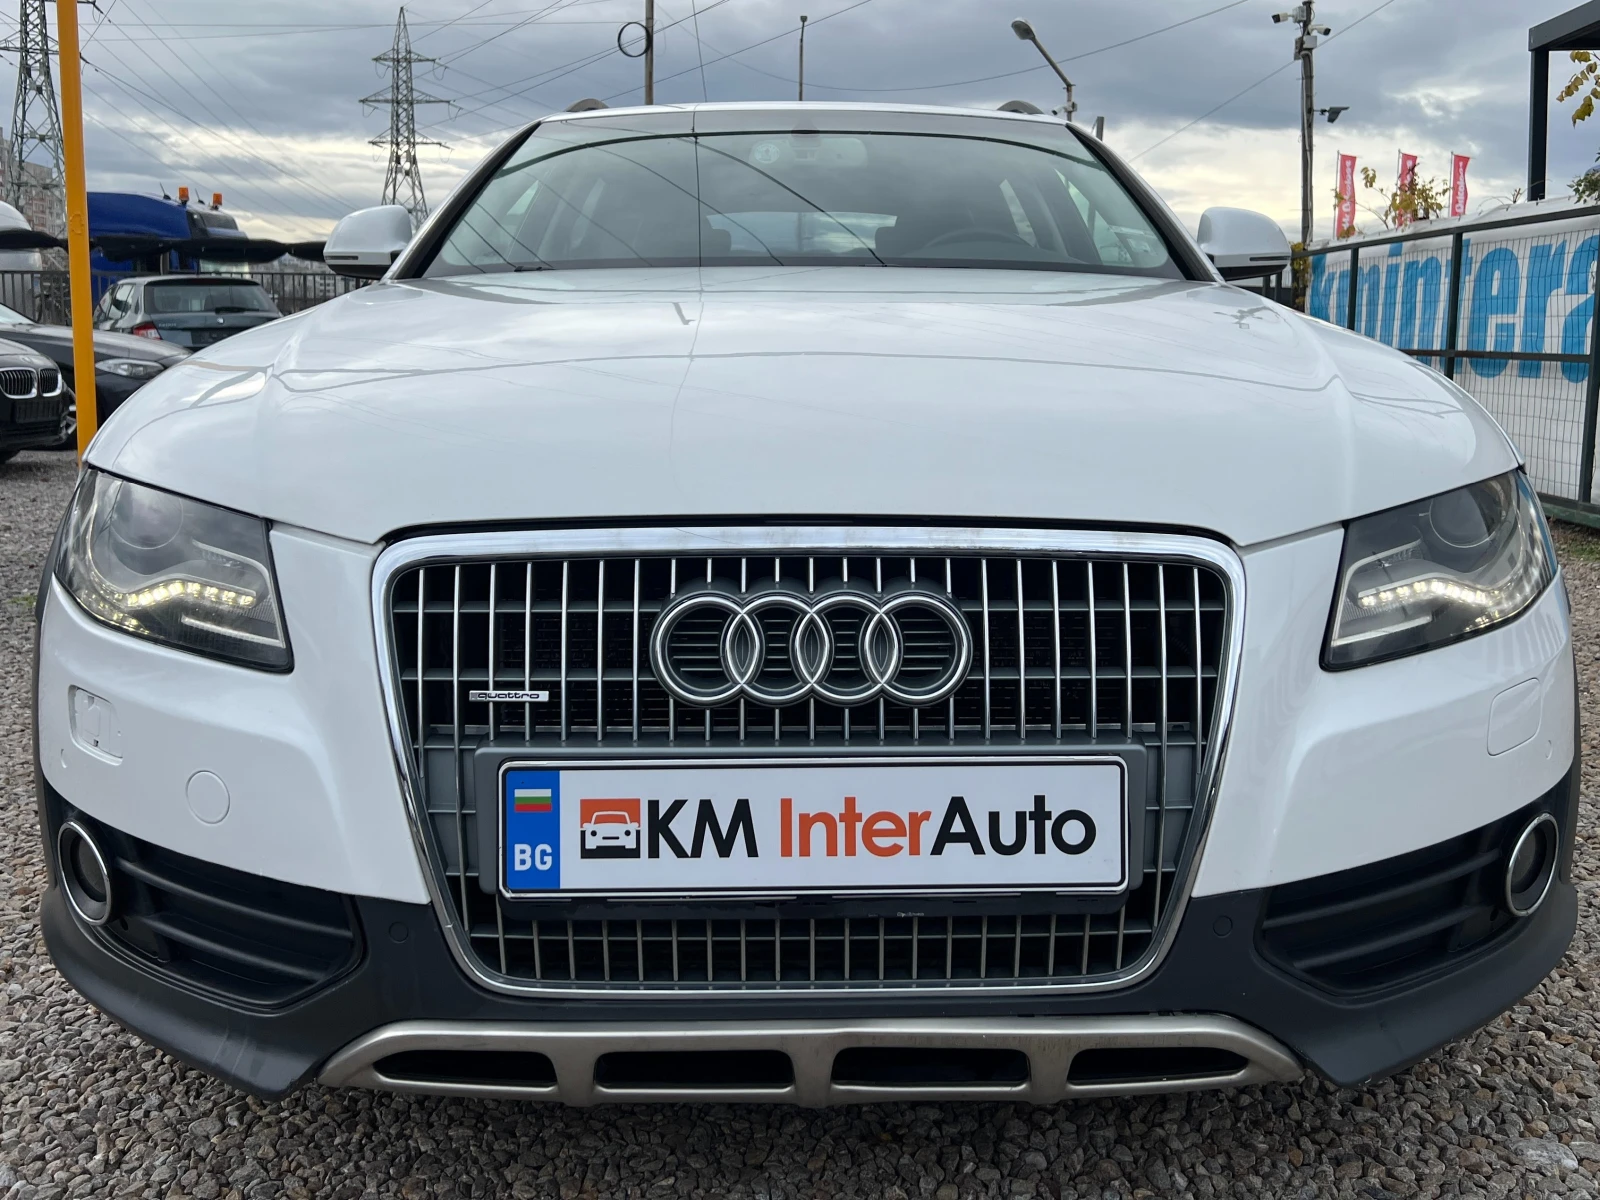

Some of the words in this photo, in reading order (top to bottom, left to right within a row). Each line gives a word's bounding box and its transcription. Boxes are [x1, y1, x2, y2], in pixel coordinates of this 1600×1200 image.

[478, 692, 540, 700] quattro
[648, 798, 759, 859] KM
[780, 794, 1097, 857] InterAuto
[514, 844, 552, 871] BG
